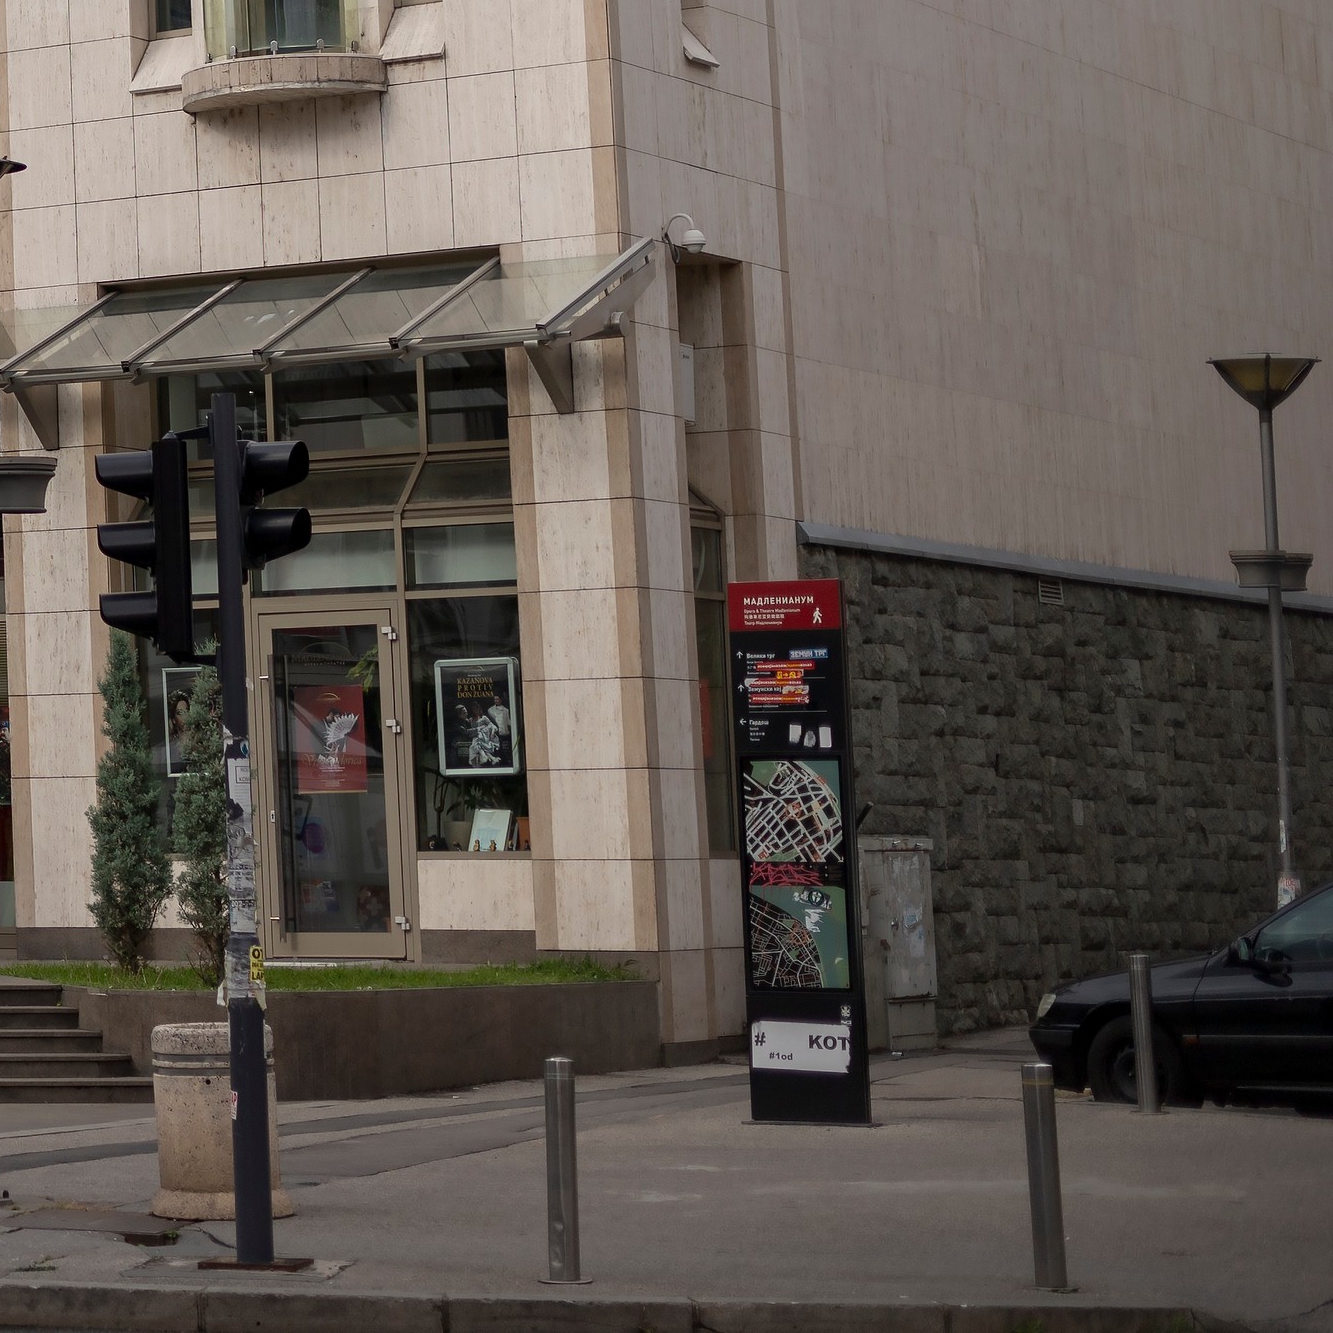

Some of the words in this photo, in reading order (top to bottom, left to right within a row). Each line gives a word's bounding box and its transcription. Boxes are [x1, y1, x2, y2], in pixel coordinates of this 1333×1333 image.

[743, 596, 814, 606] МАДЛЕНИАНУМ
[457, 677, 493, 685] KAZANOVA
[754, 1032, 766, 1046] #
[769, 1052, 793, 1061] #1od
